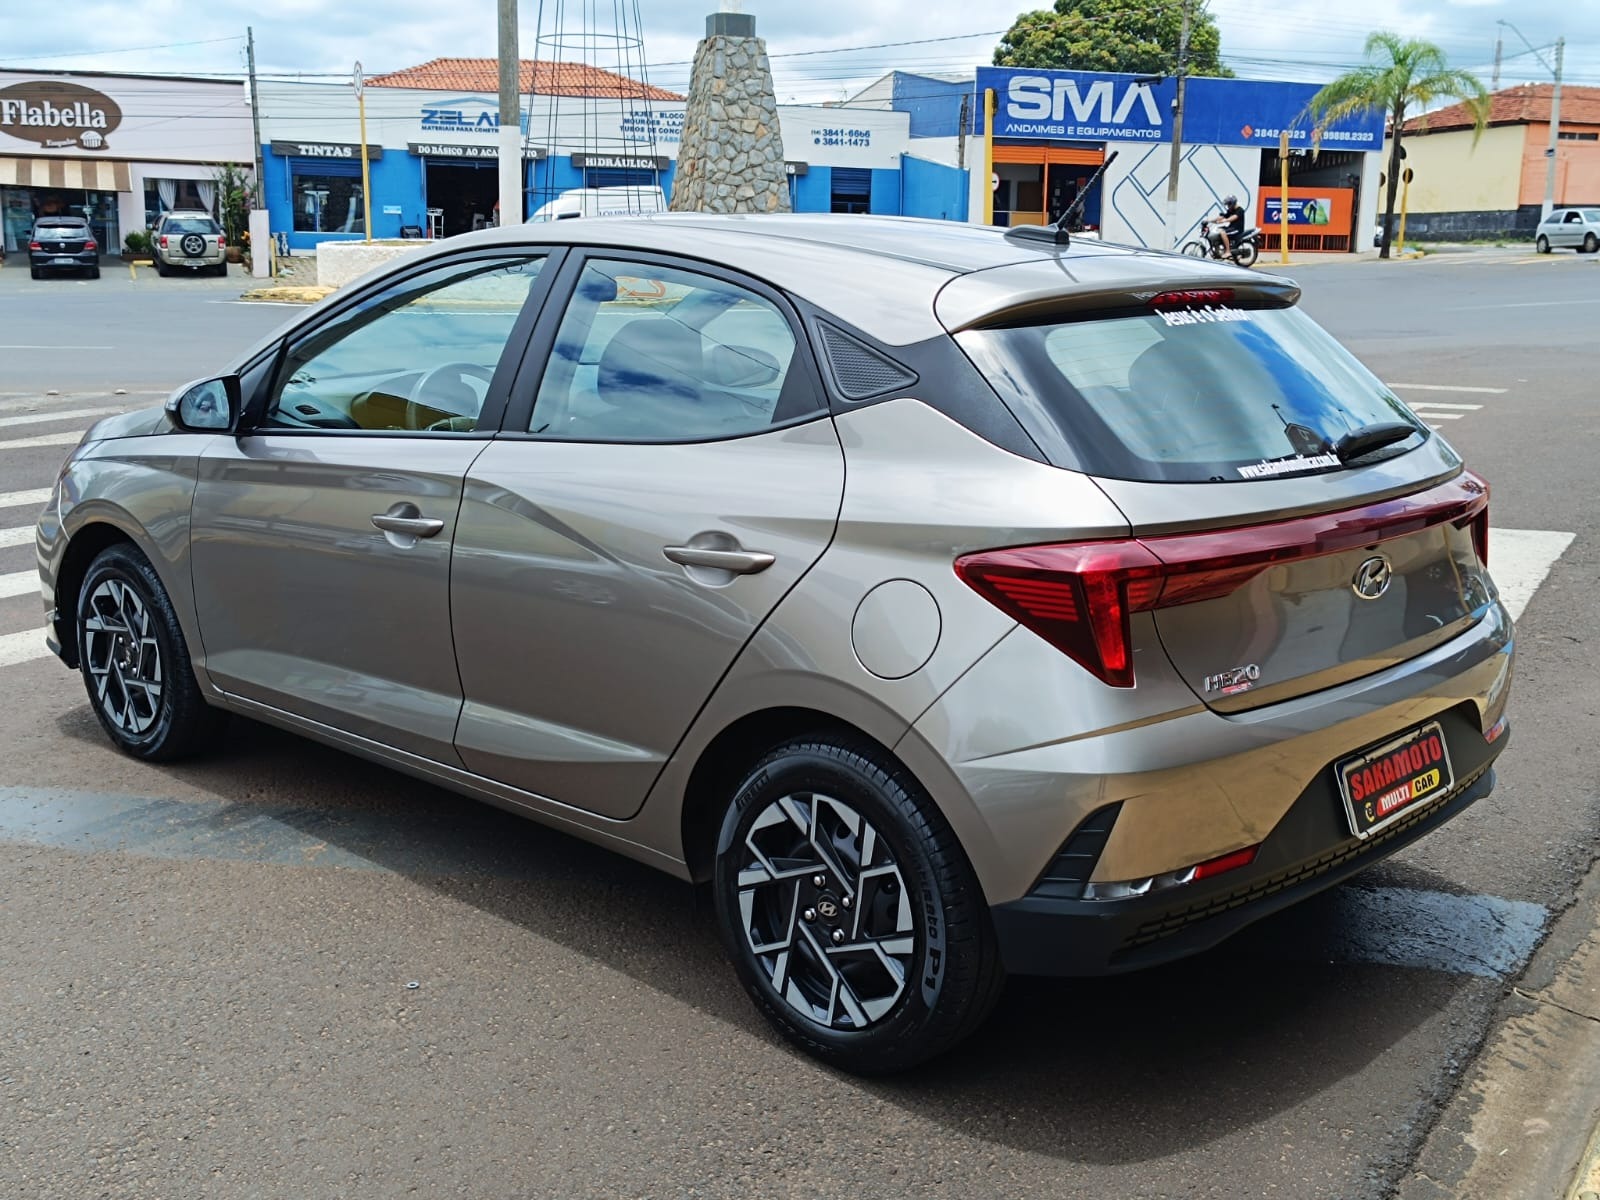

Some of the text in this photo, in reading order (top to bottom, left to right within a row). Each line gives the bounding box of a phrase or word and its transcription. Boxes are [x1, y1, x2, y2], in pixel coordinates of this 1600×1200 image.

[1, 99, 107, 128] Flabella
[1007, 76, 1162, 125] SMA
[1005, 124, 1161, 138] ANDAIMES E EQUIPAMENTOS
[298, 145, 353, 157] TINTAS
[418, 146, 431, 154] DO
[431, 145, 463, 155] BÁSICO
[466, 148, 478, 156] AO
[1204, 664, 1261, 692] HB20
[1351, 735, 1442, 801] SAKAMOTO
[1381, 774, 1434, 811] MULTI CAR
